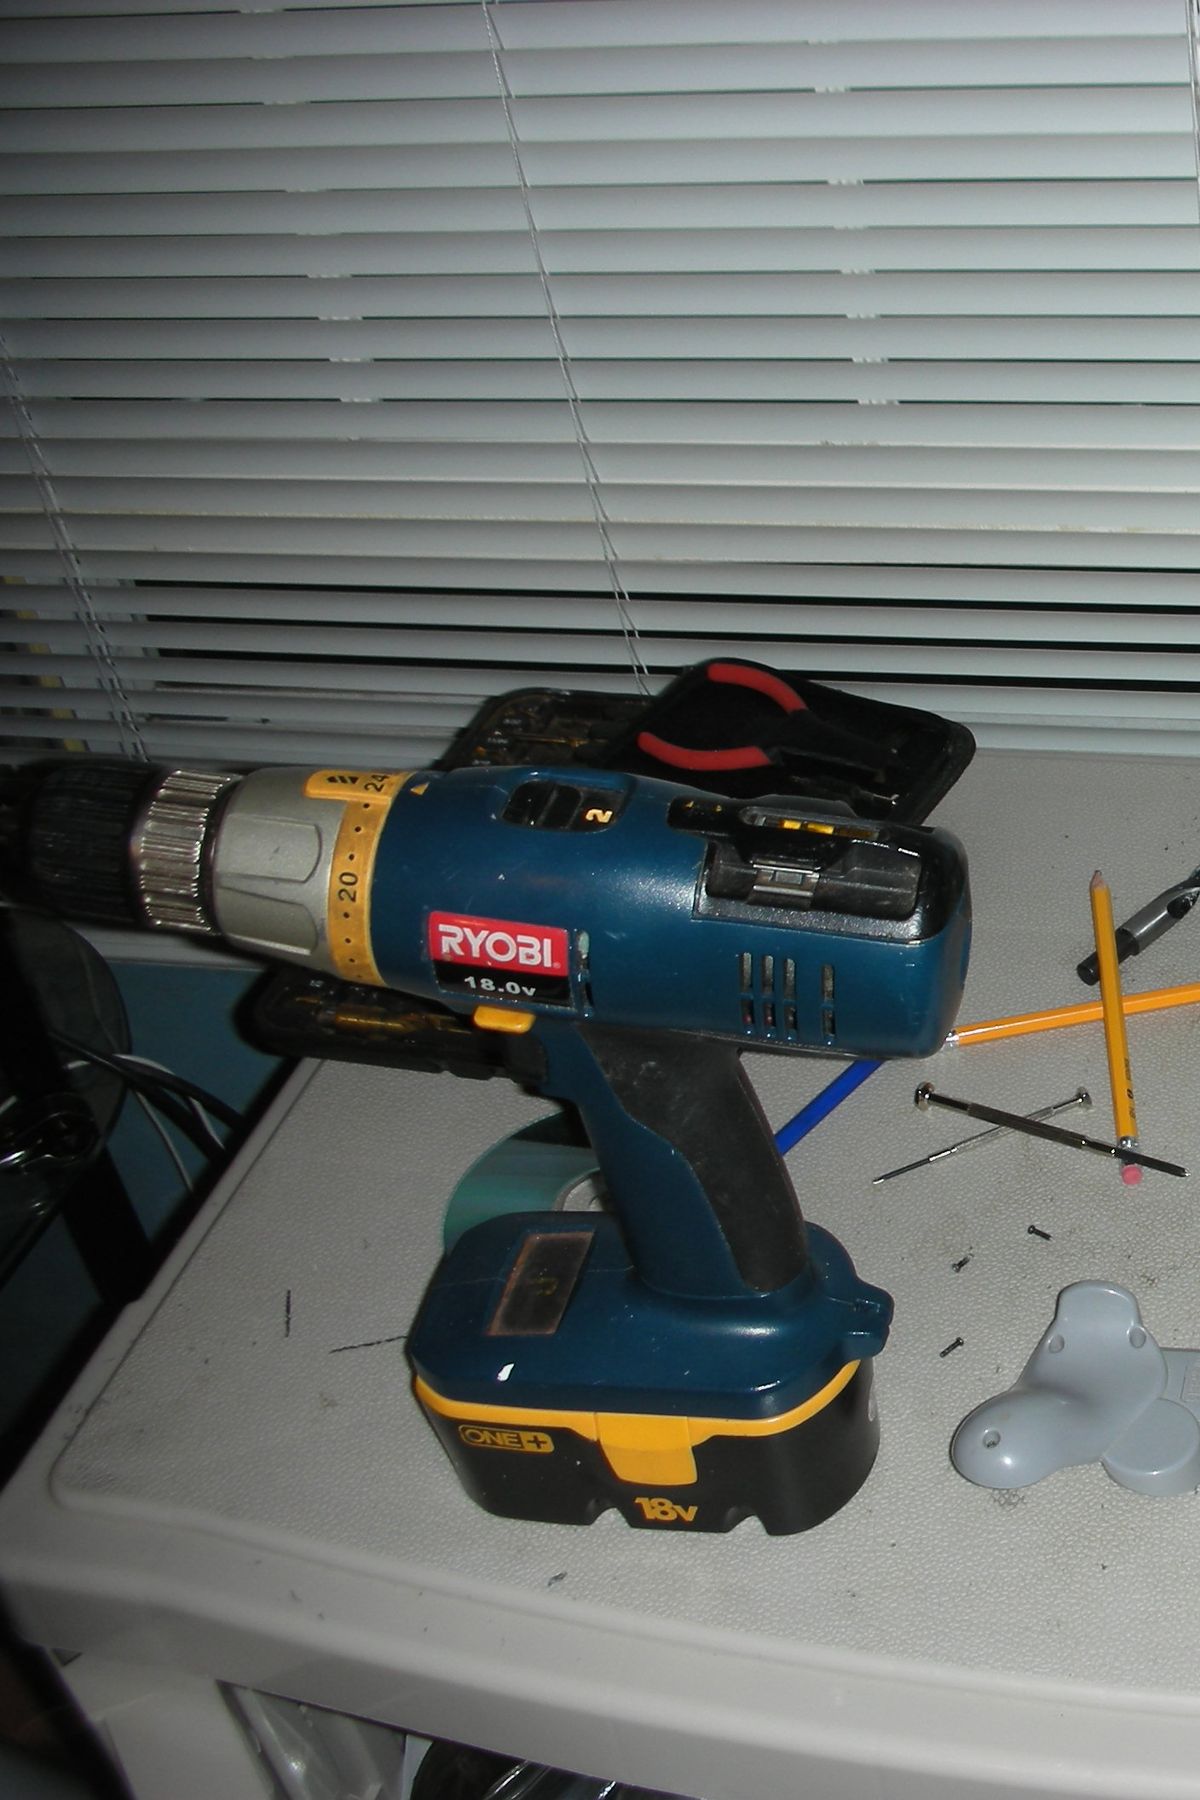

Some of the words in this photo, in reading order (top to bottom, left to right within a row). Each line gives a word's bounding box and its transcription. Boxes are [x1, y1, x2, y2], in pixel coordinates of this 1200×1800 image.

[364, 774, 389, 793] 24
[585, 808, 613, 824] 2
[338, 872, 358, 903] 20
[438, 924, 552, 968] RYOBI
